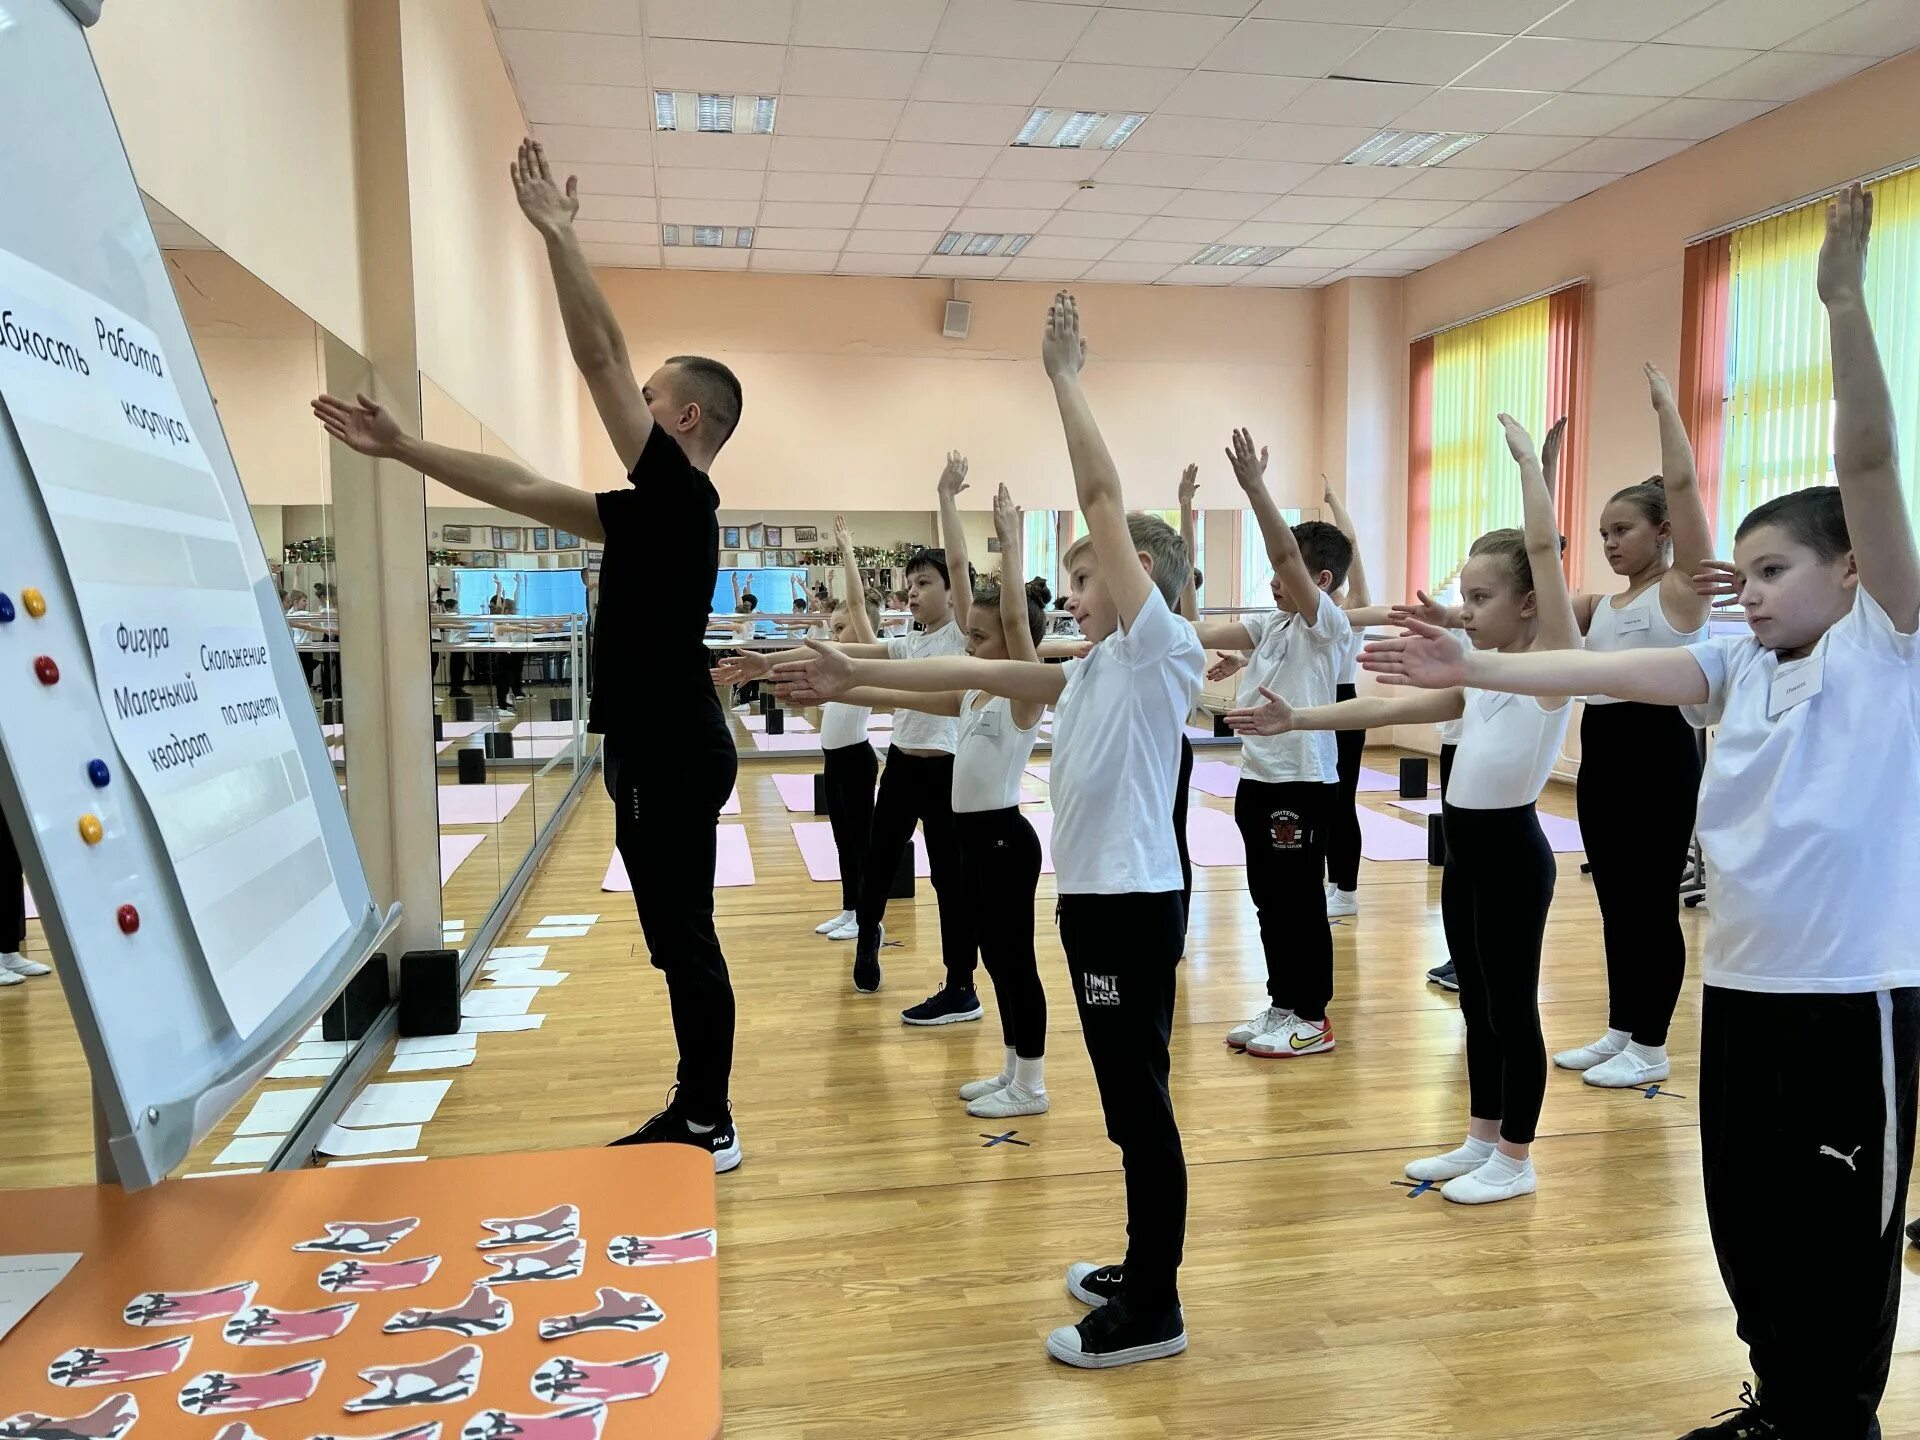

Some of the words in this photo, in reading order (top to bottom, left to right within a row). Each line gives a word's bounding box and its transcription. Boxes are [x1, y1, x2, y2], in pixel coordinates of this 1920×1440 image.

[95, 318, 163, 377] Работа
[121, 399, 190, 446] корпуса
[116, 622, 169, 658] Фигура
[200, 643, 267, 673] Скольжение
[114, 672, 198, 719] Маленький
[221, 705, 237, 725] по
[237, 696, 281, 725] паркету
[148, 733, 213, 772] квадрат
[1083, 972, 1118, 991] LIMIT
[1085, 989, 1121, 1006] LESS
[713, 1135, 730, 1145] FILA
